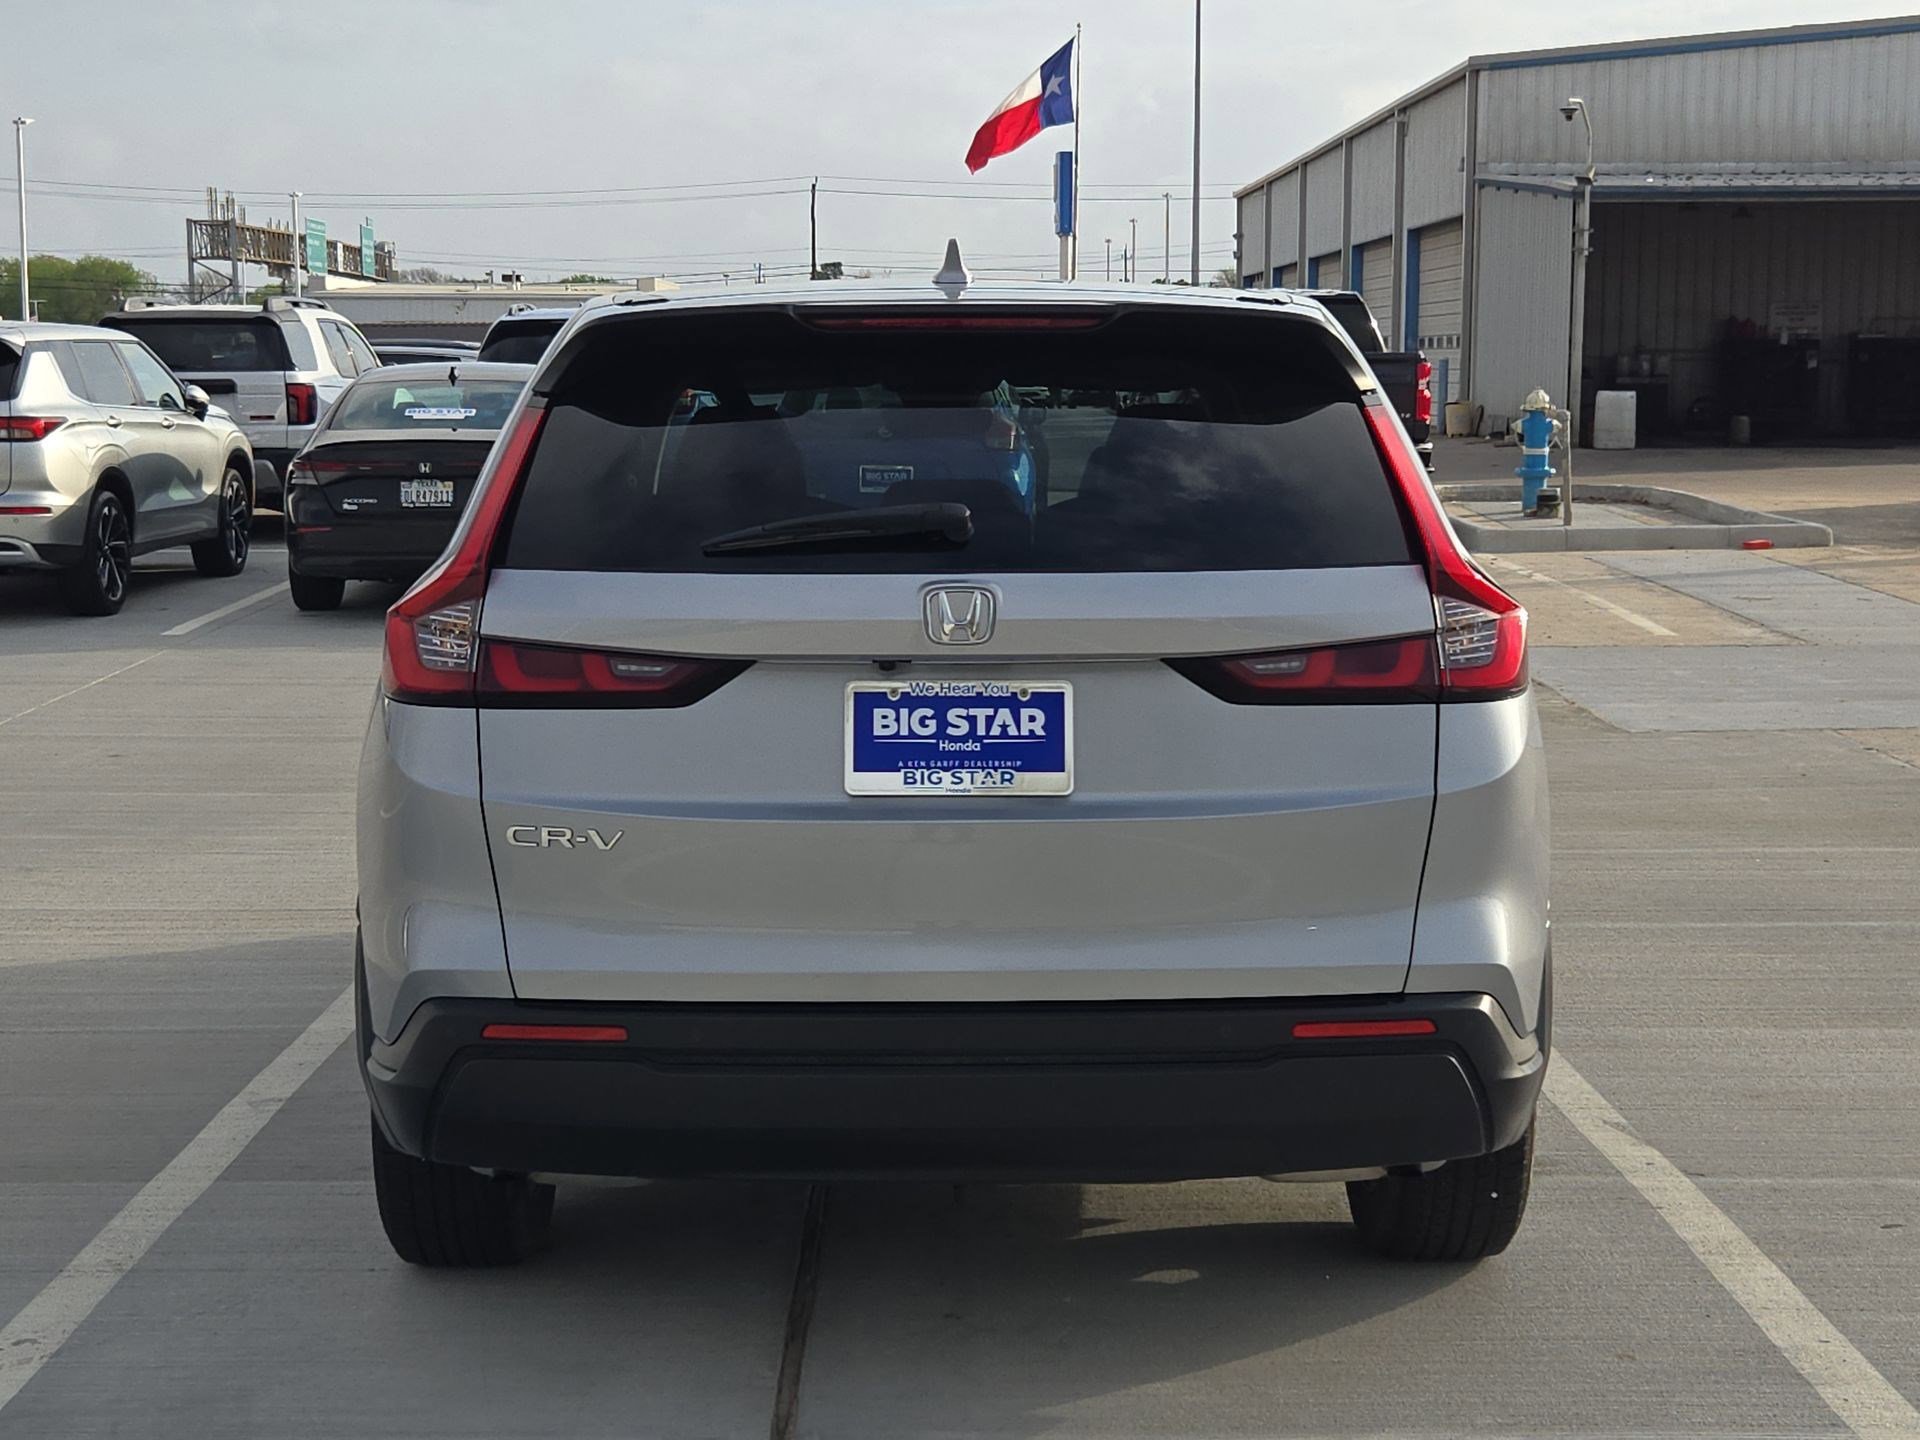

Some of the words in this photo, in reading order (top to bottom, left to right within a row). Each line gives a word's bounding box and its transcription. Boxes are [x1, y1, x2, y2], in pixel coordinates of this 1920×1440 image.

[909, 682, 936, 696] We
[939, 682, 976, 696] Hear
[981, 682, 1009, 696] You
[873, 708, 937, 736] BIG
[946, 708, 1046, 736] STAR
[939, 740, 981, 751] Honda
[903, 770, 943, 785] BIG
[950, 770, 1015, 785] STAR
[506, 825, 623, 850] CR-V
